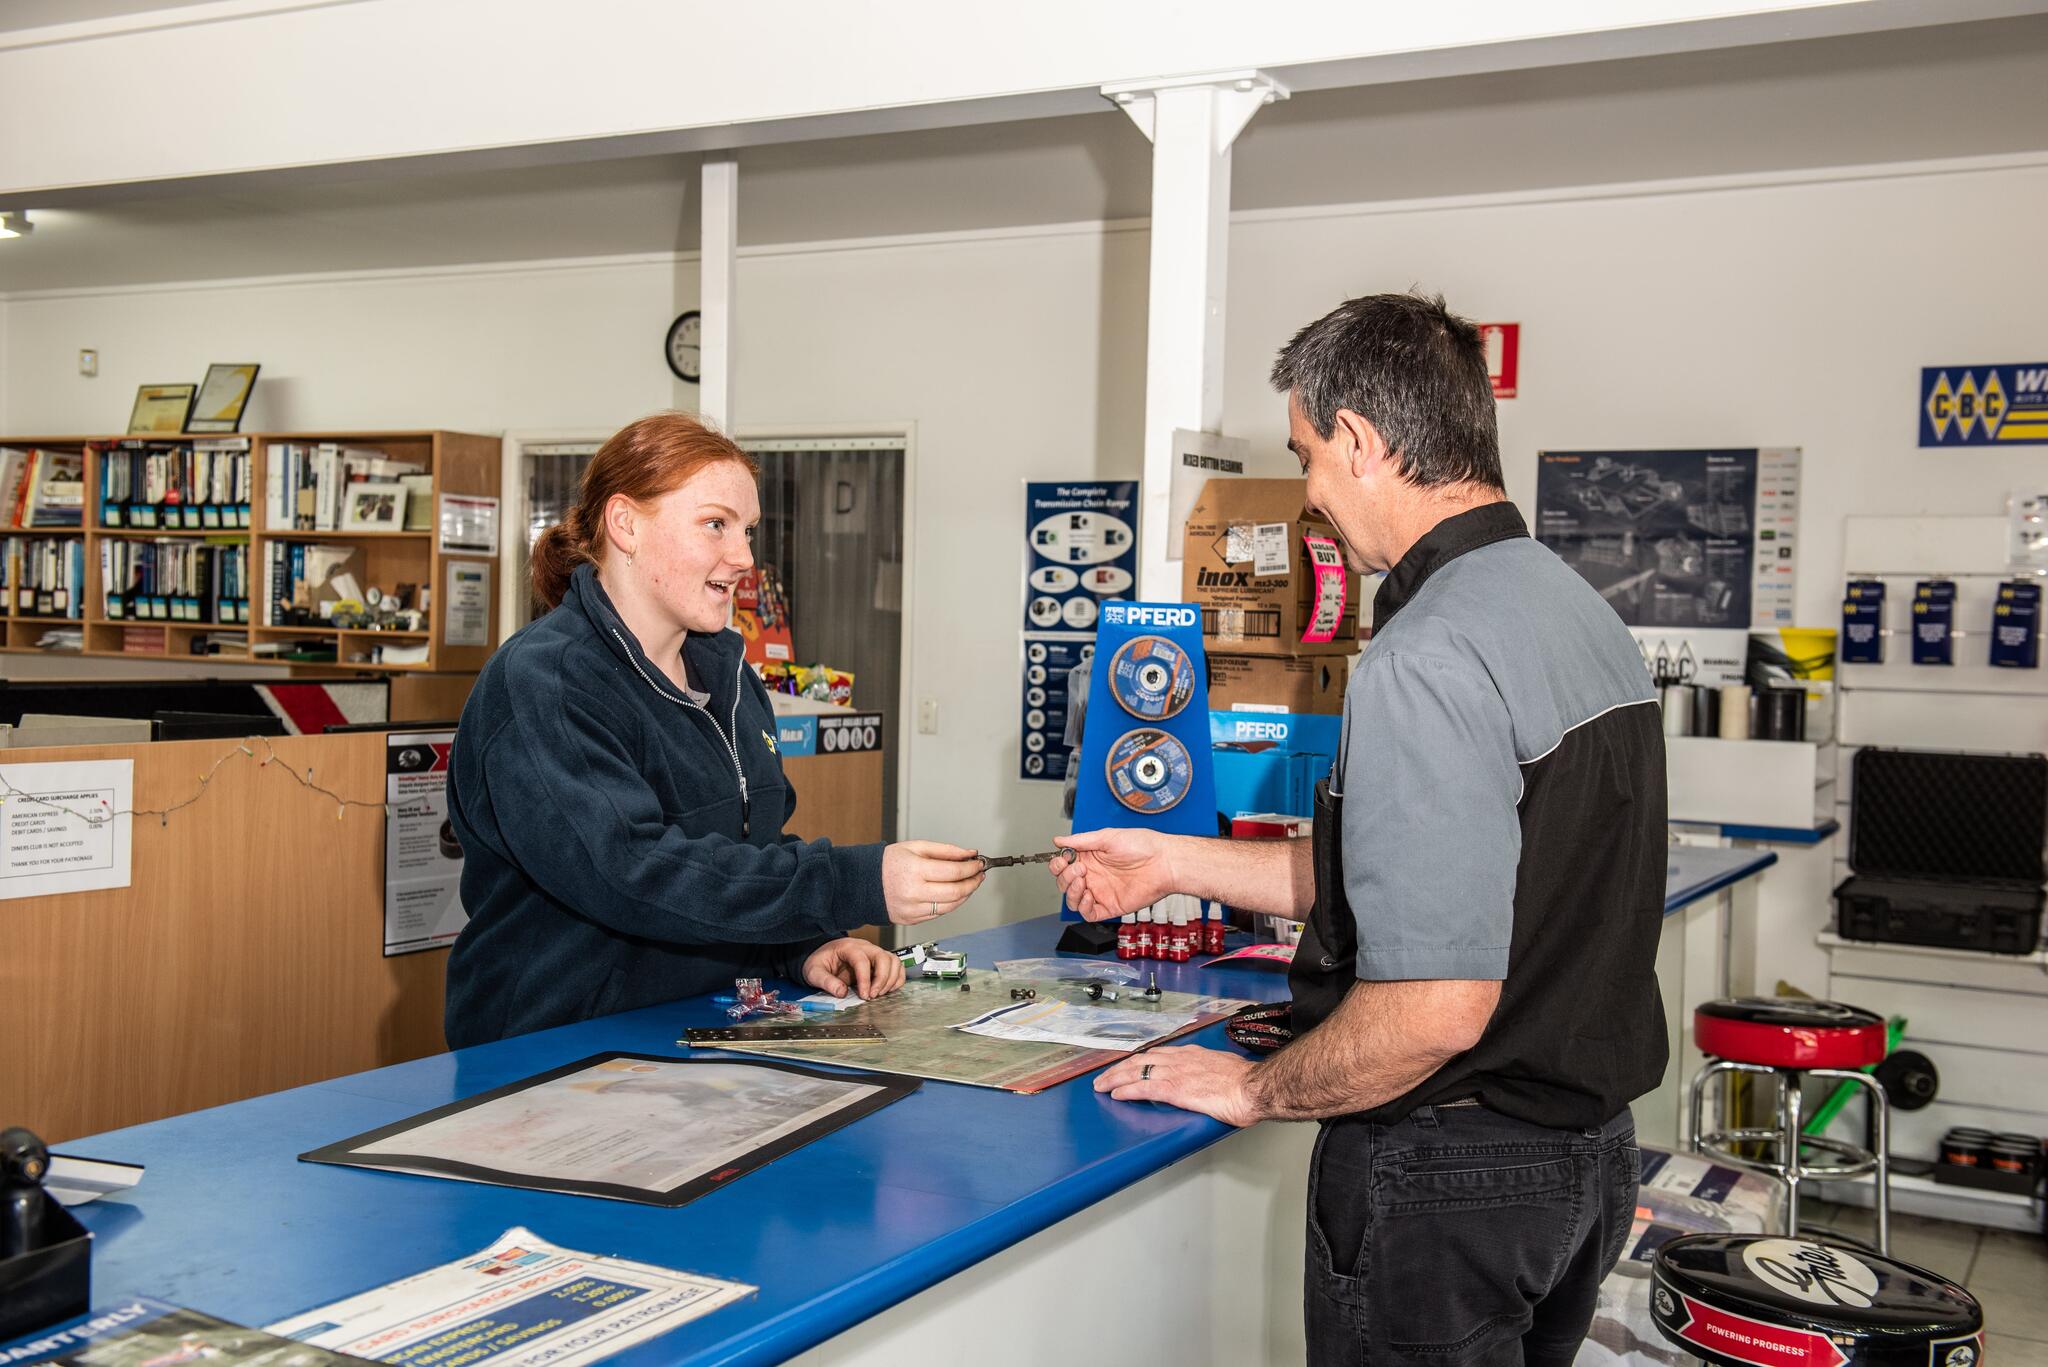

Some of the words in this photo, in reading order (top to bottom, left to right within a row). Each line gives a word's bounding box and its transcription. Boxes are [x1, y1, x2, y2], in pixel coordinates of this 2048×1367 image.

[1934, 391, 2000, 420] CBC
[1056, 487, 1070, 496] The
[1071, 487, 1108, 498] Complete
[1034, 499, 1082, 509] Transmission
[1083, 498, 1105, 508] Chain
[1106, 499, 1131, 511] Range
[1310, 542, 1337, 552] BARGAIN
[1316, 551, 1337, 564] BUY
[1197, 566, 1249, 587] inox
[1127, 607, 1197, 627] PFERD
[1235, 721, 1288, 740] PFERD
[11, 861, 28, 869] THANK
[65, 855, 93, 864] PATRONAGE
[355, 1328, 410, 1351] CARD
[410, 1287, 514, 1330] SURCHARGE
[517, 1263, 585, 1293] APPLIES
[563, 1328, 610, 1355] YOUR
[609, 1286, 703, 1331] PATRONAGE
[1706, 1323, 1751, 1345] POWERING
